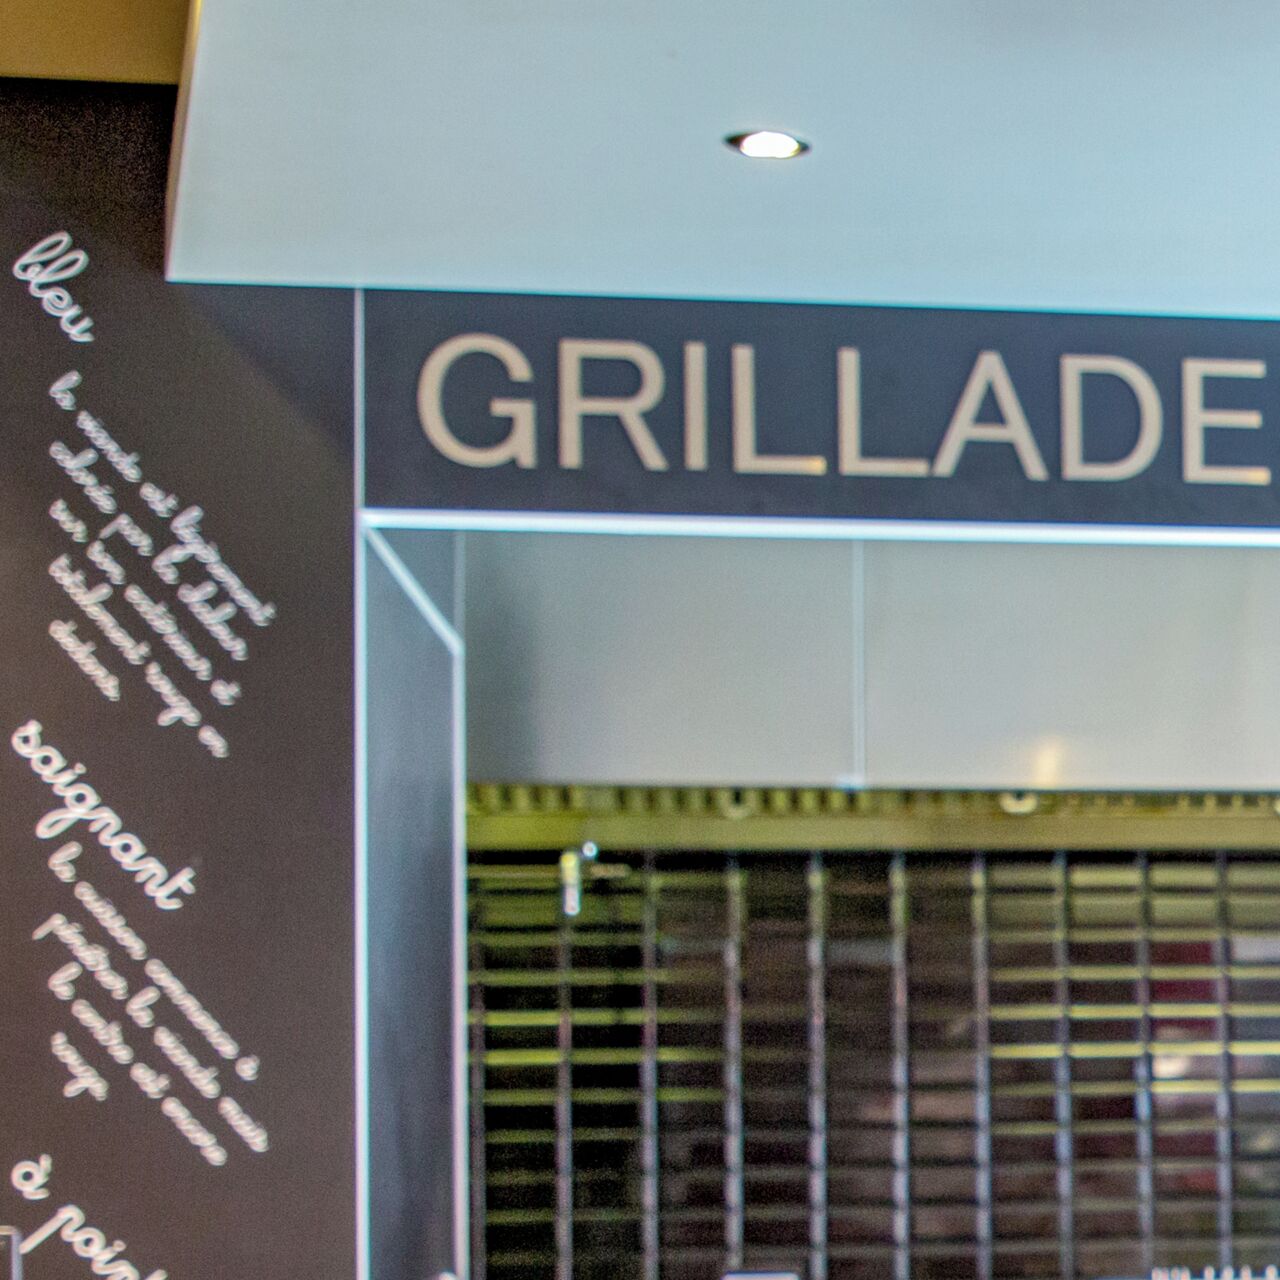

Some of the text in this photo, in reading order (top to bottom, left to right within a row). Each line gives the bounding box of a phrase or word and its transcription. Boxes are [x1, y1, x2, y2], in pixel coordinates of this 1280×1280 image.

[13, 231, 94, 342] bleu
[12, 720, 195, 910] saignant
[11, 1153, 52, 1199] à
